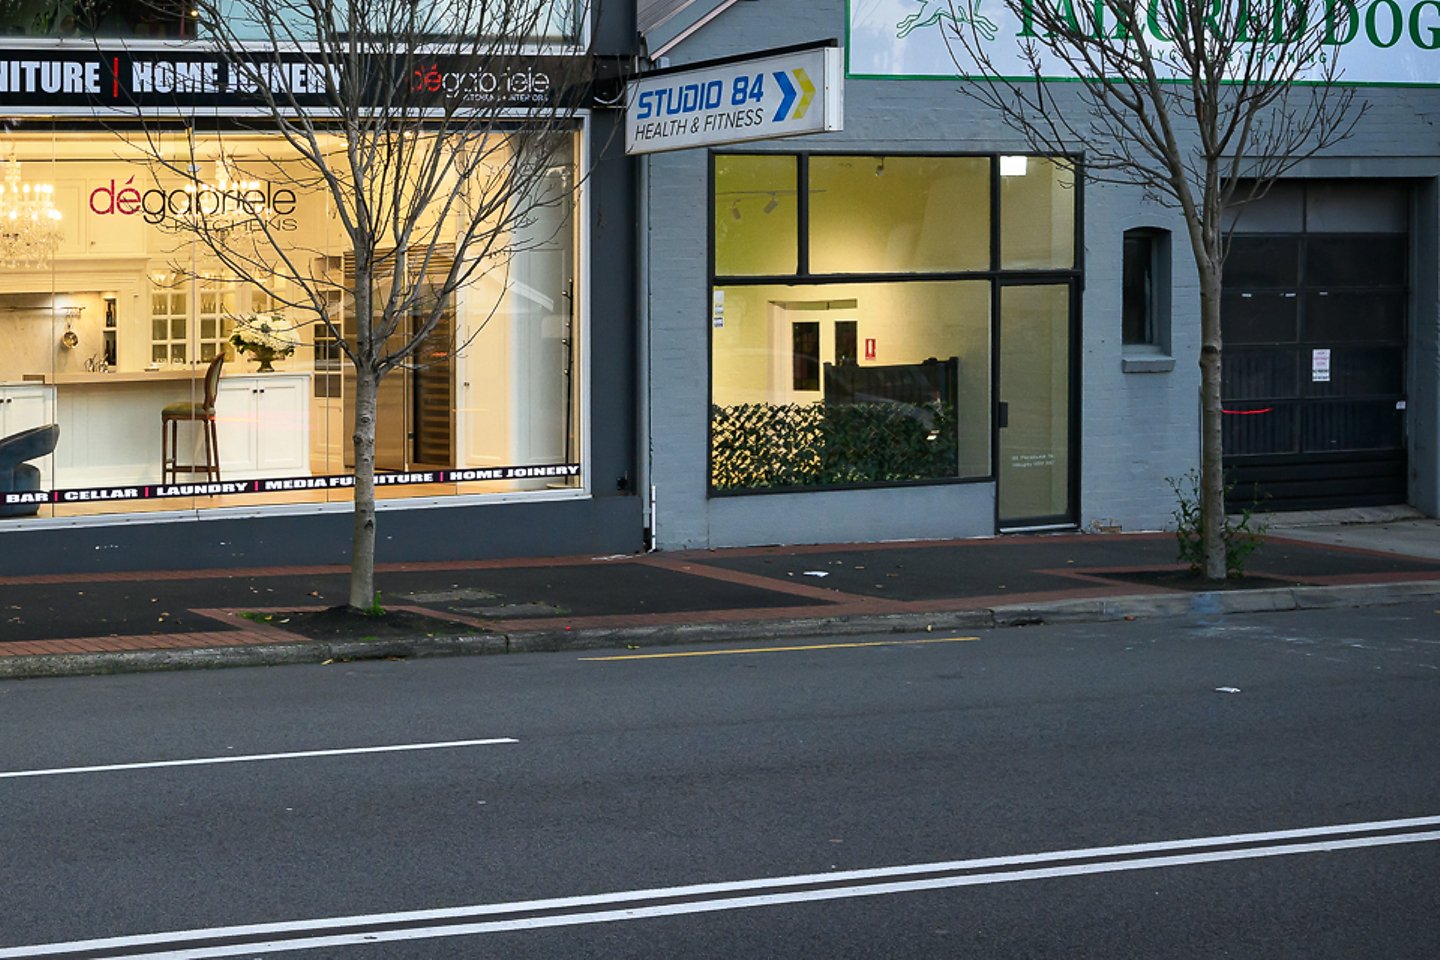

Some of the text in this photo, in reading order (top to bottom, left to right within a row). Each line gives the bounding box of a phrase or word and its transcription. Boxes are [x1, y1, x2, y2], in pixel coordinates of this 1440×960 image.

[132, 62, 220, 94] HOME
[637, 73, 765, 120] STUDIO 84
[635, 108, 765, 141] HEALTH & FITNESS
[6, 492, 49, 504] BAR
[64, 488, 139, 501] CELLAR
[156, 482, 248, 497] LAUNDRY
[264, 477, 328, 490] MEDIA
[329, 472, 434, 487] FUITURE
[449, 470, 504, 481] HOME
[505, 465, 580, 478] JOINERY
